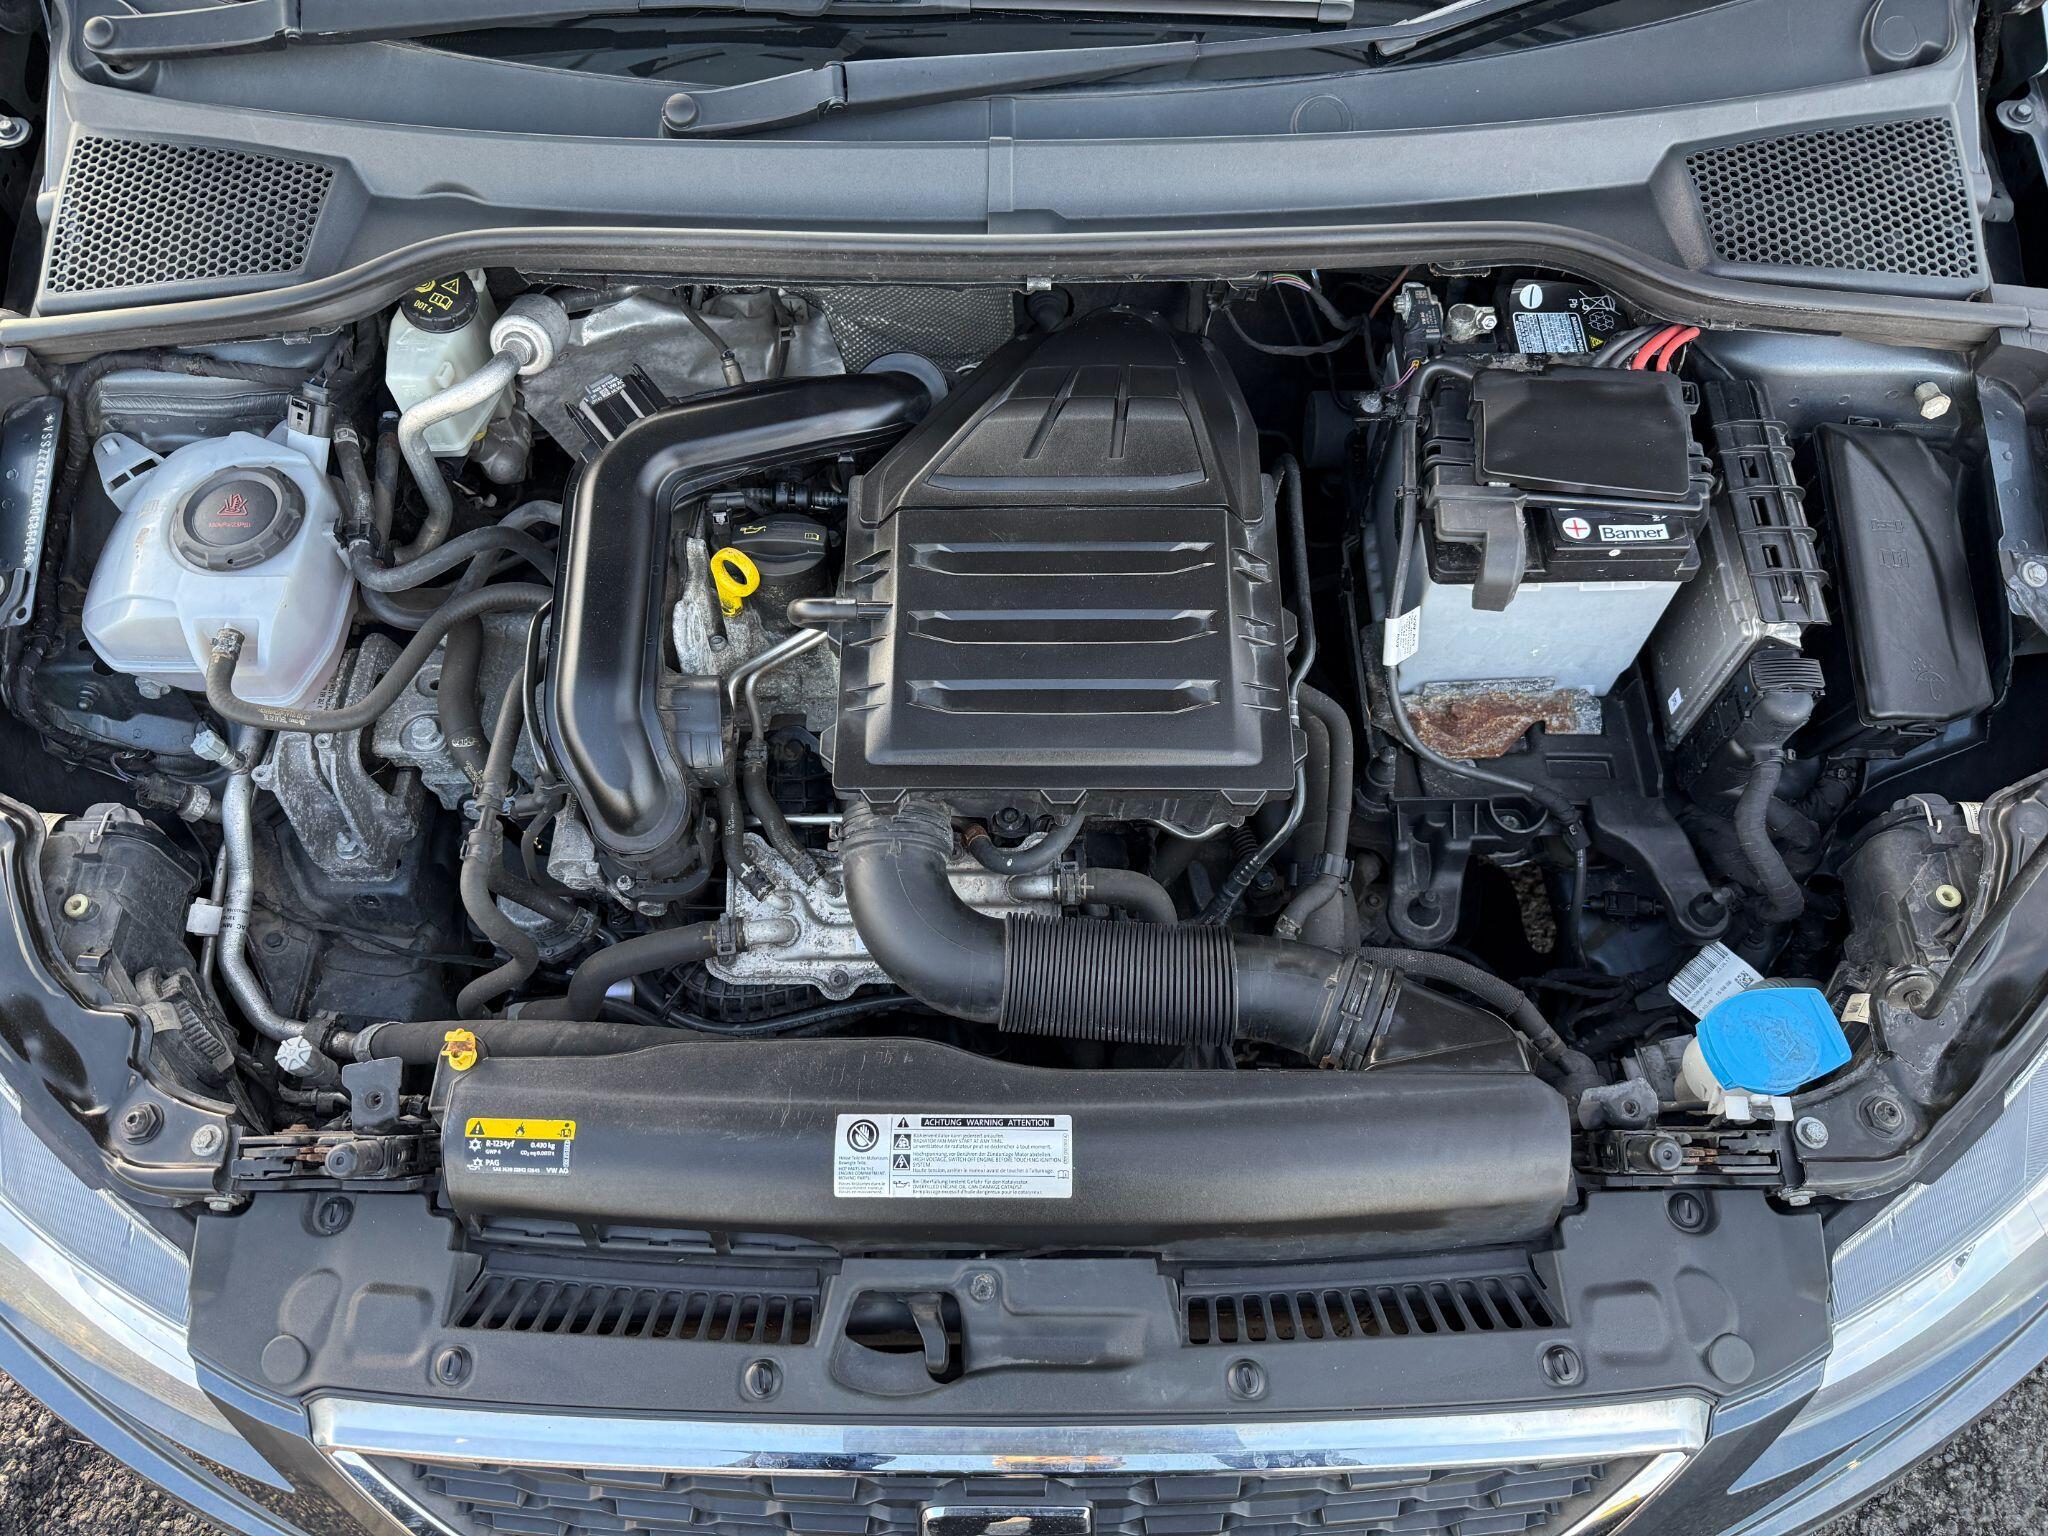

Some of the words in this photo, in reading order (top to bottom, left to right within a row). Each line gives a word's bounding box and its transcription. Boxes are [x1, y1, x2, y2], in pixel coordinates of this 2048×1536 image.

[414, 300, 428, 310] DOT
[427, 306, 433, 314] 4
[1602, 527, 1664, 540] Banner
[924, 1118, 961, 1127] ACHTUNG
[966, 1118, 1003, 1127] WARNING
[1007, 1118, 1050, 1127] ATTENTION
[548, 1142, 556, 1150] kg
